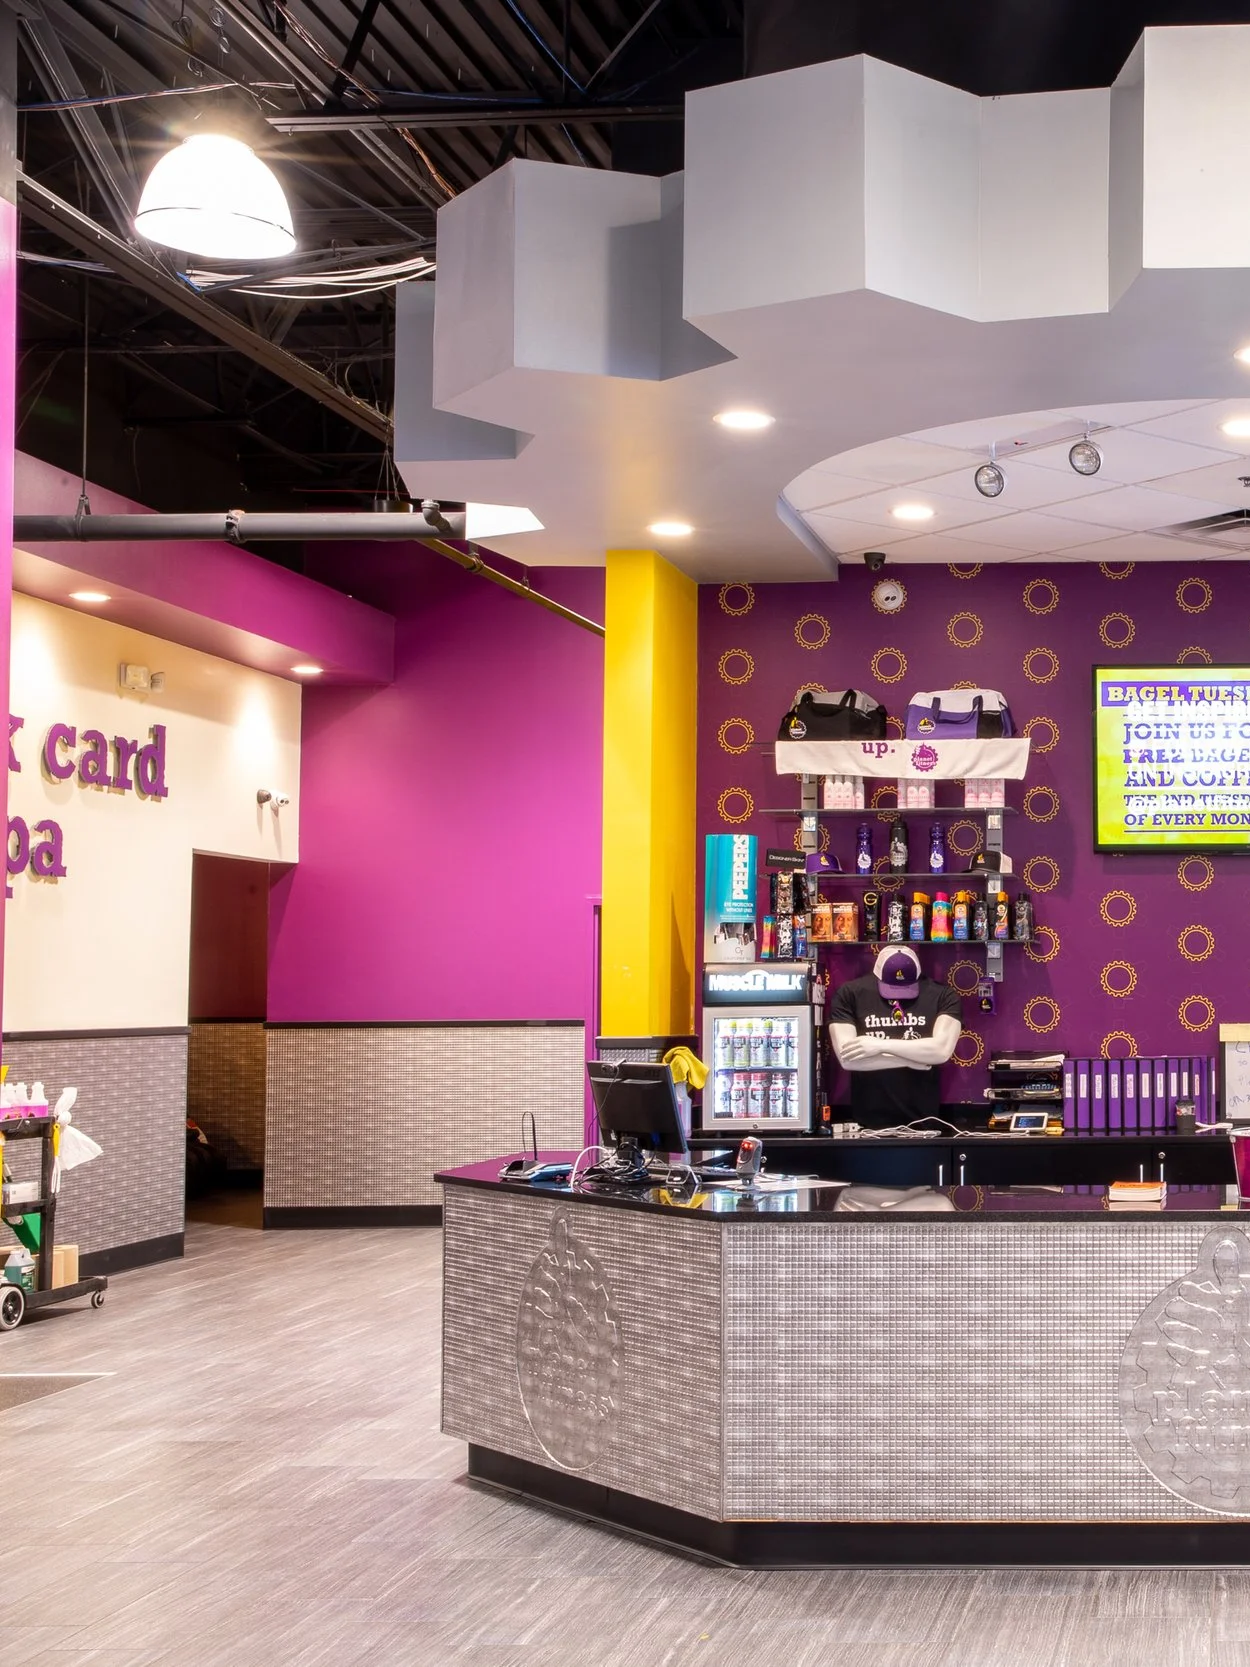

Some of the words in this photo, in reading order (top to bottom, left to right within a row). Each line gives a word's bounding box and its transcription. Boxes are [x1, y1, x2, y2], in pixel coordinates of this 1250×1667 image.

[1107, 686, 1185, 701] BAGEL
[1123, 723, 1181, 744] JOIN
[1188, 723, 1216, 739] US
[44, 722, 168, 798] card
[861, 742, 896, 759] up.
[1123, 770, 1175, 787] AND
[1123, 813, 1148, 826] OF
[1152, 813, 1206, 826] EVERY
[732, 834, 750, 900] PEEPERS
[709, 971, 765, 992] MUSCLE
[765, 973, 804, 992] MILK
